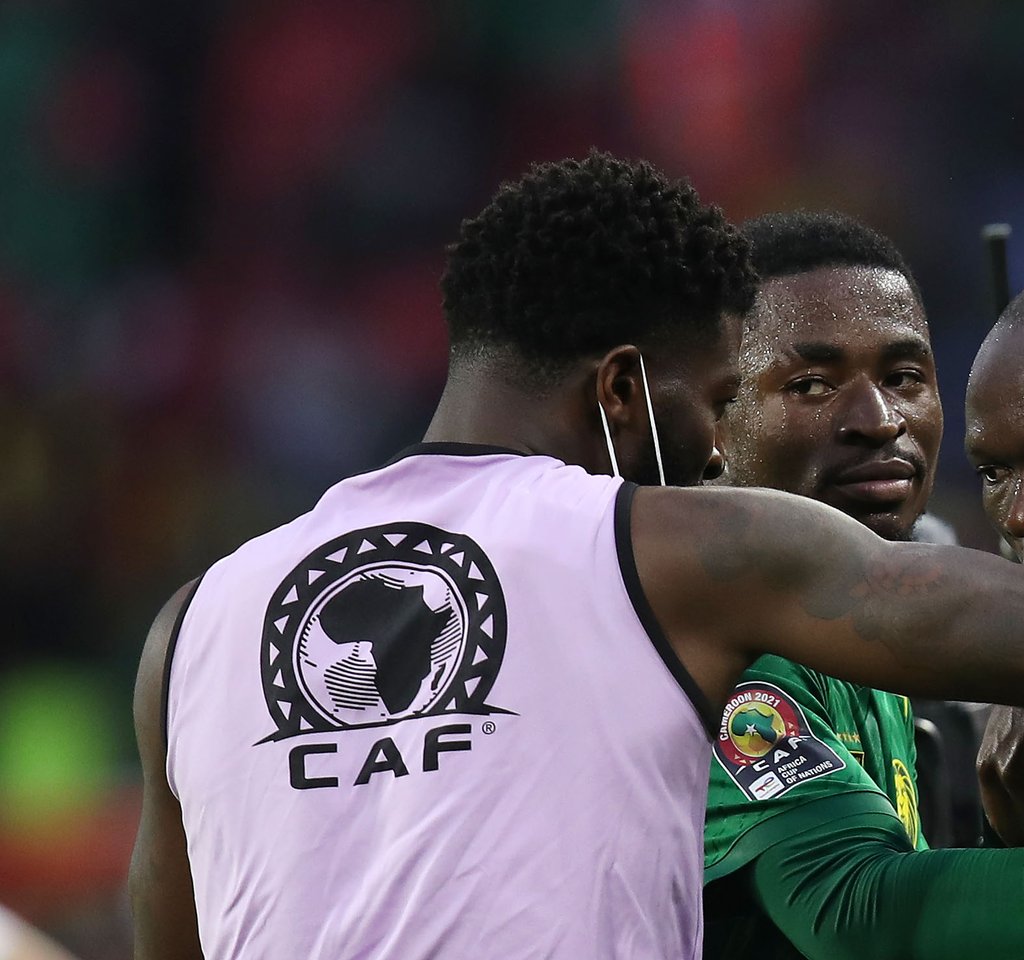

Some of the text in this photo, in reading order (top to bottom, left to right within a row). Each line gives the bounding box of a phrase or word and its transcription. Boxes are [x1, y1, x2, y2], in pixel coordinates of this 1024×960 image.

[755, 692, 780, 708] 2021
[288, 723, 473, 790] CAF
[777, 755, 807, 774] AFRICA
[781, 768, 798, 779] CUP
[786, 760, 833, 785] OF NATIONS
